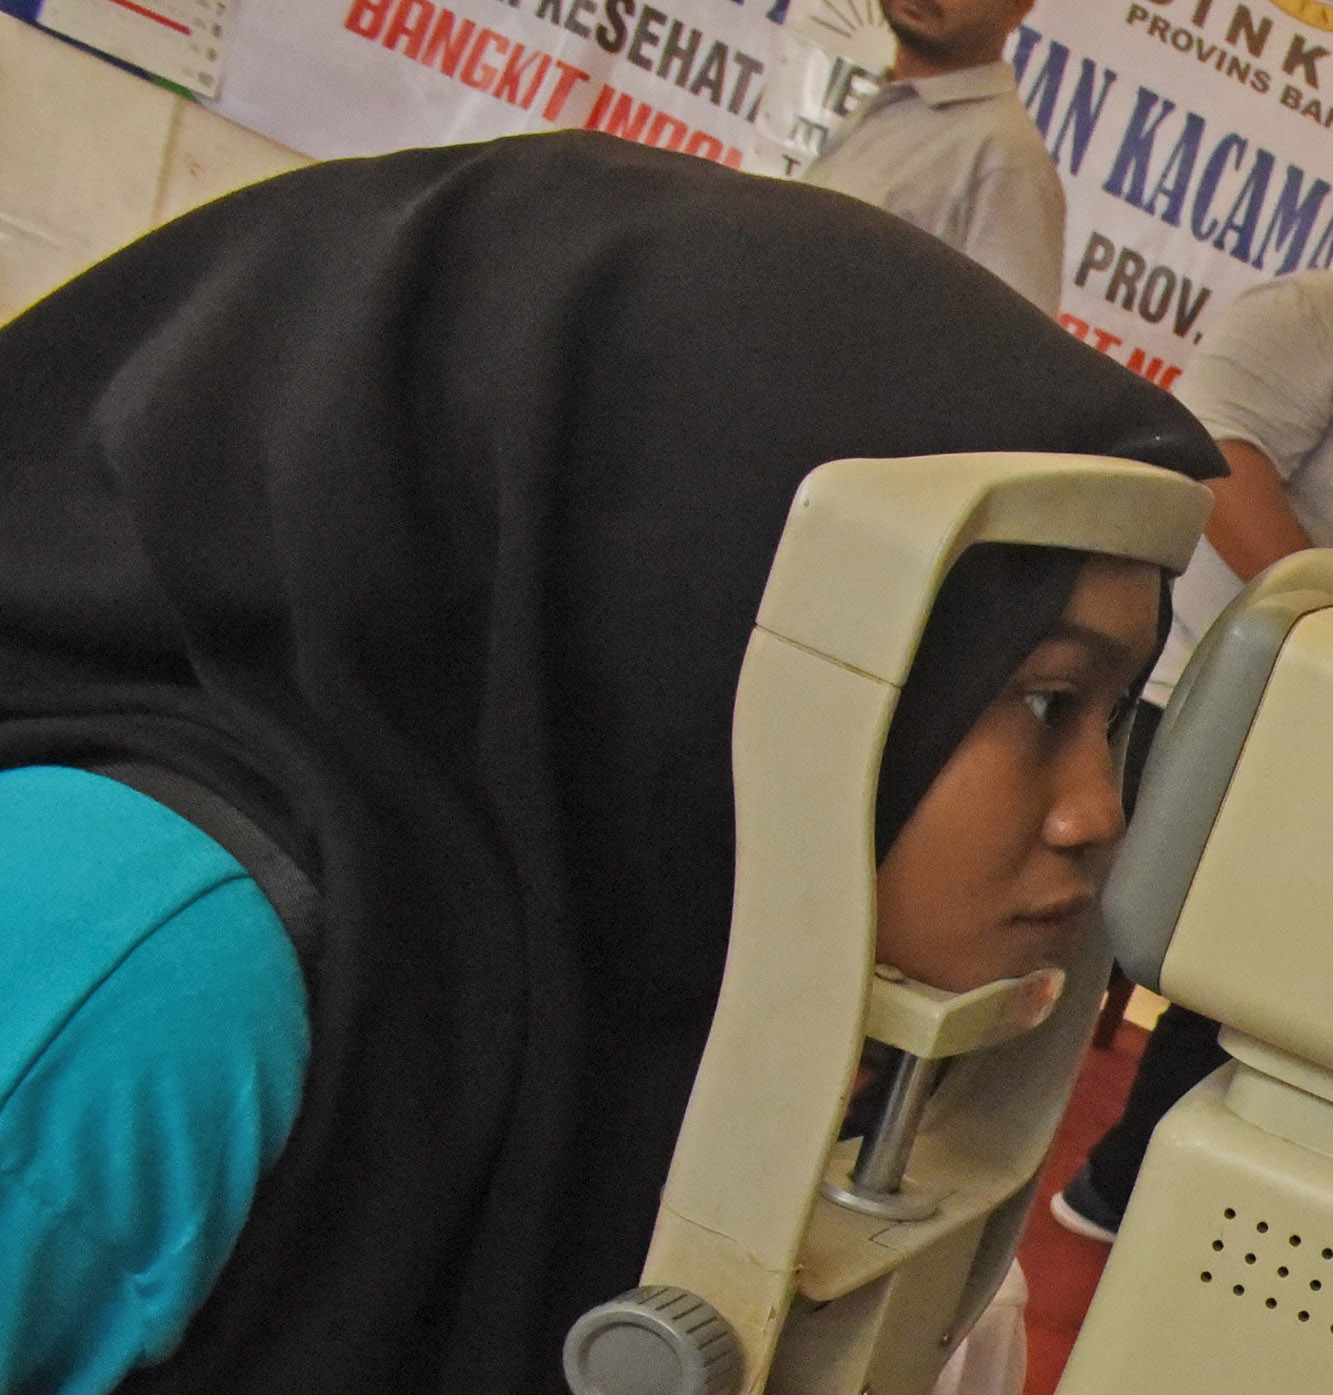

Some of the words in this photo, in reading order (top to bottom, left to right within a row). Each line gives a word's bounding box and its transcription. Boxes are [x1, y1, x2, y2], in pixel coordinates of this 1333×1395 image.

[344, 0, 591, 123] BANGKIT
[1125, 3, 1272, 95] PROVINS
[1073, 231, 1213, 346] PROV.
